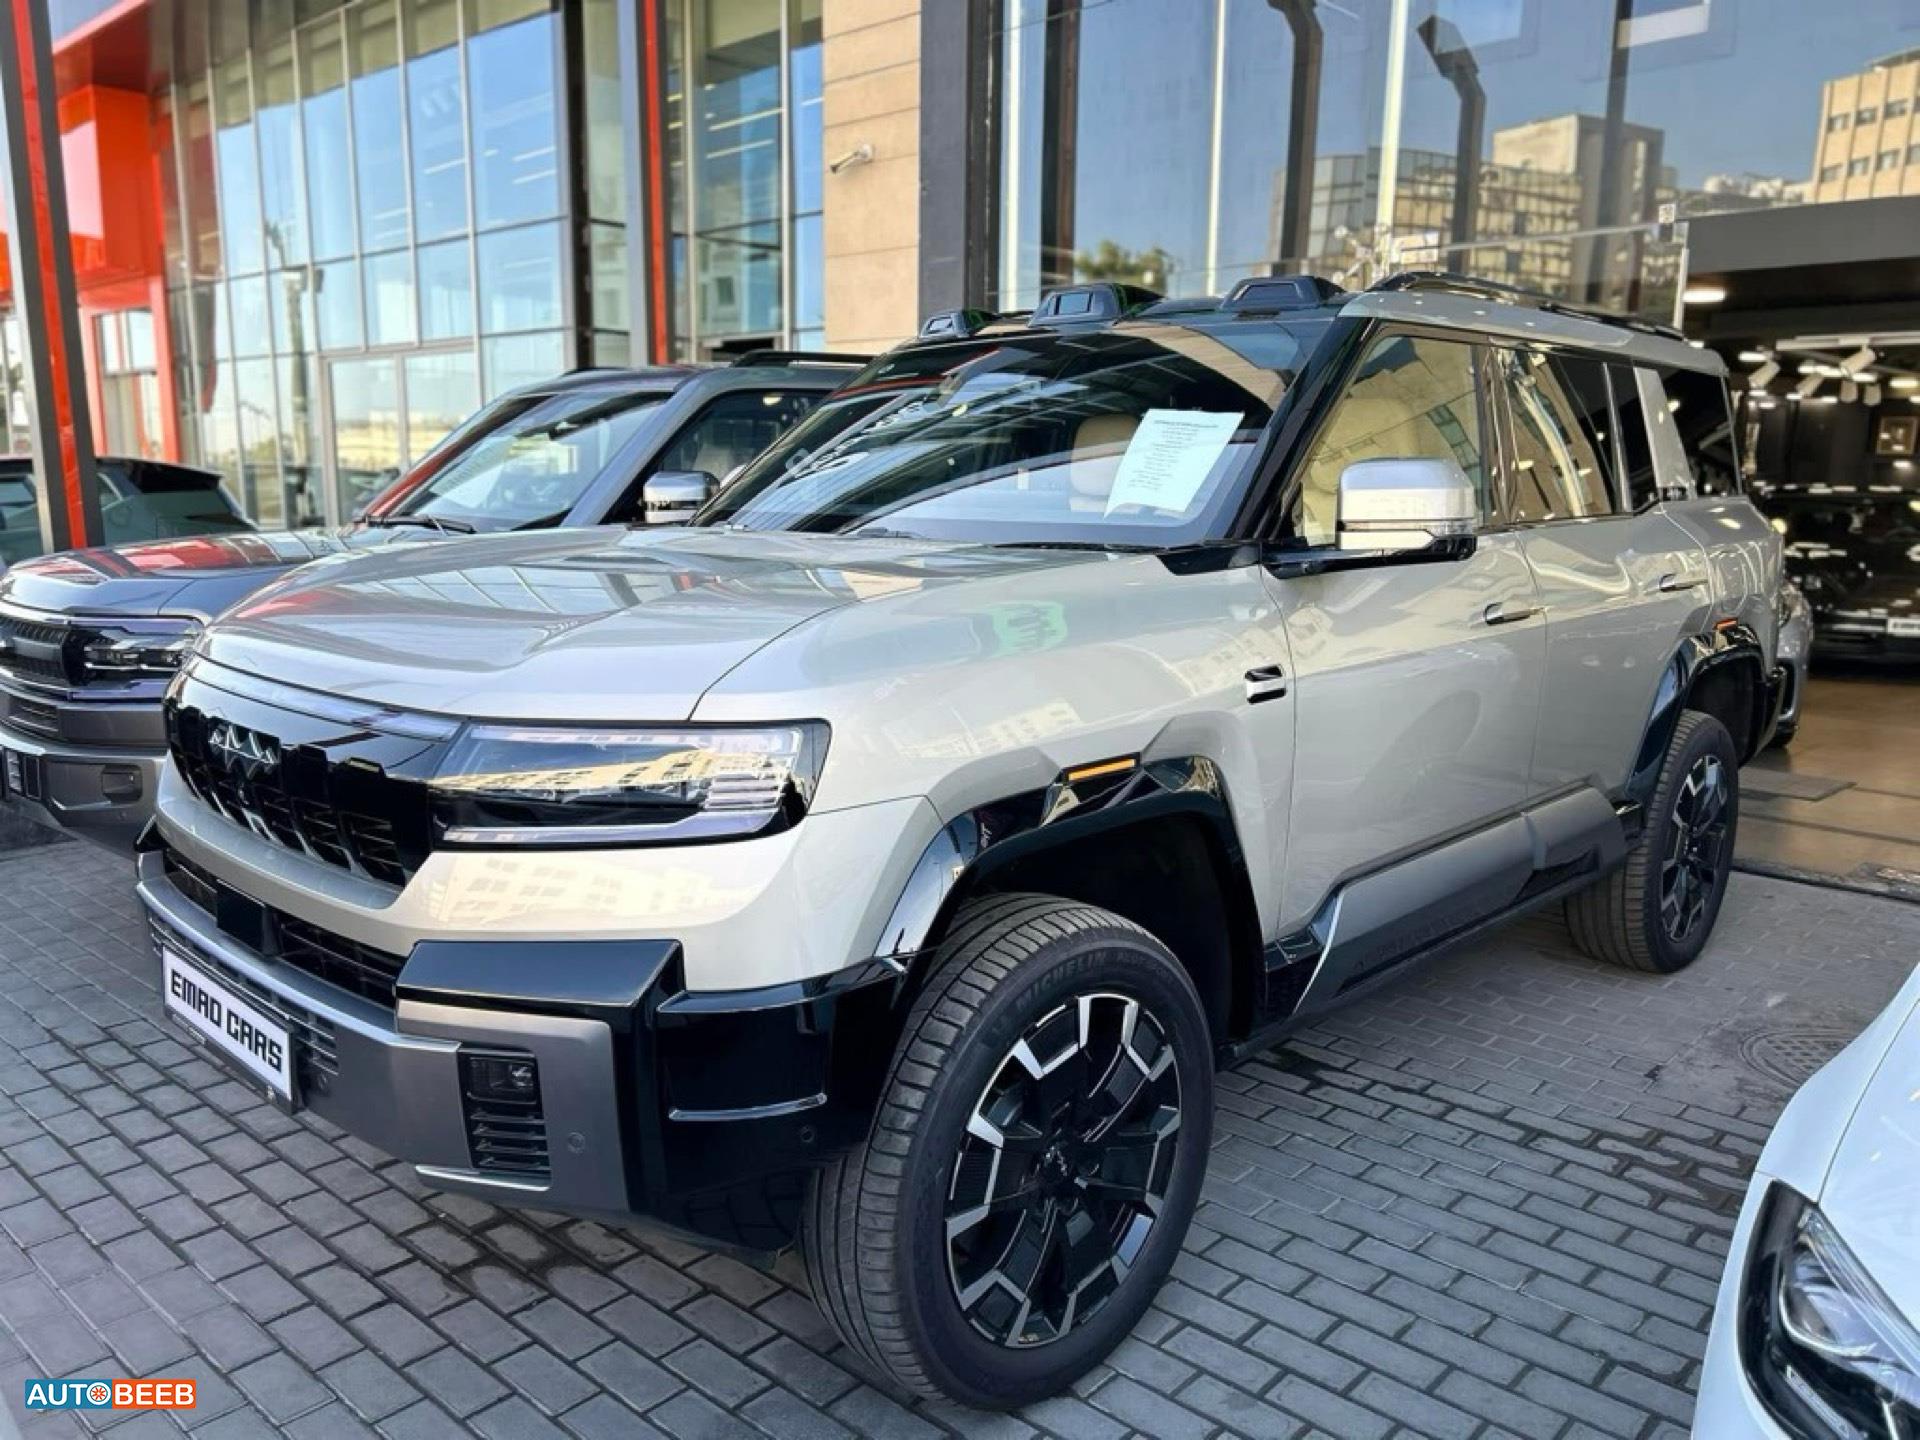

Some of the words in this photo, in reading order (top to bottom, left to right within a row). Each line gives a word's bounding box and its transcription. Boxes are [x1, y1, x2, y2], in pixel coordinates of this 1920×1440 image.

[171, 968, 222, 1028] EMAD
[226, 1008, 282, 1073] CARS
[1015, 951, 1107, 1012] MICHELIN
